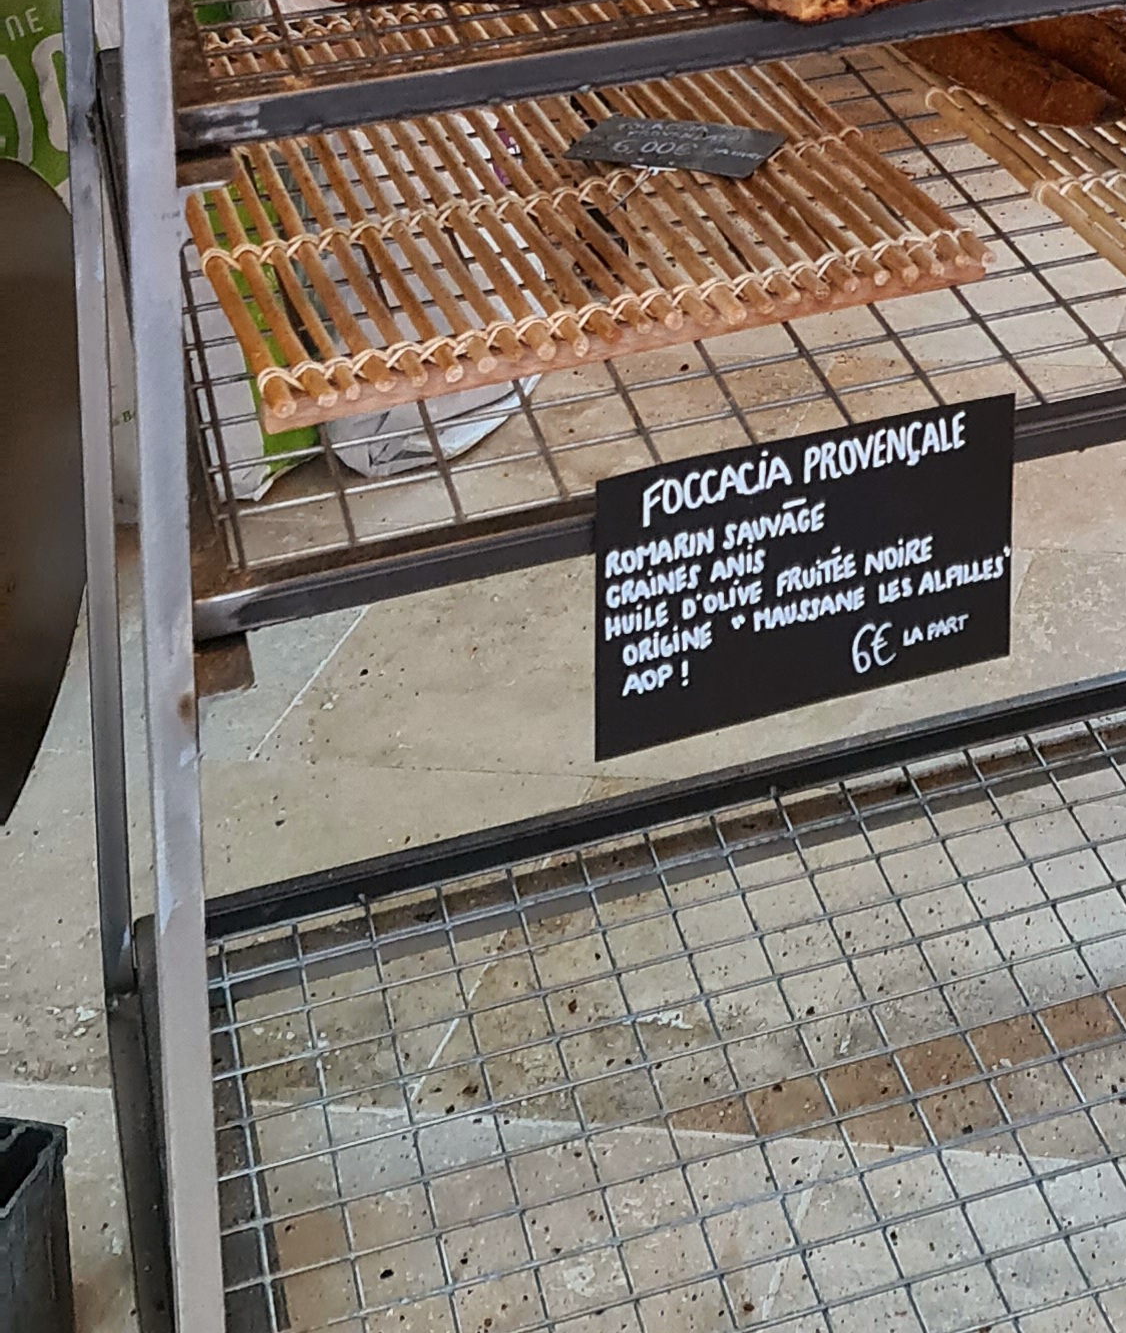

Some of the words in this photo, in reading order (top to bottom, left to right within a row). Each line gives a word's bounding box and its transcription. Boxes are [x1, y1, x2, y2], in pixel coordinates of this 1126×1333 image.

[640, 449, 794, 528] FOCCACIA
[802, 410, 967, 485] PROVENÇALE
[604, 526, 715, 580] ROMARIN
[722, 502, 826, 552] SAUVAGE
[709, 543, 767, 584] ANIS
[604, 596, 670, 642] HUILE
[864, 534, 934, 577] NOIRE
[877, 577, 915, 606] LES
[850, 621, 898, 675] 6€
[902, 626, 924, 648] LA
[926, 613, 970, 643] PART
[620, 661, 674, 698] AOP
